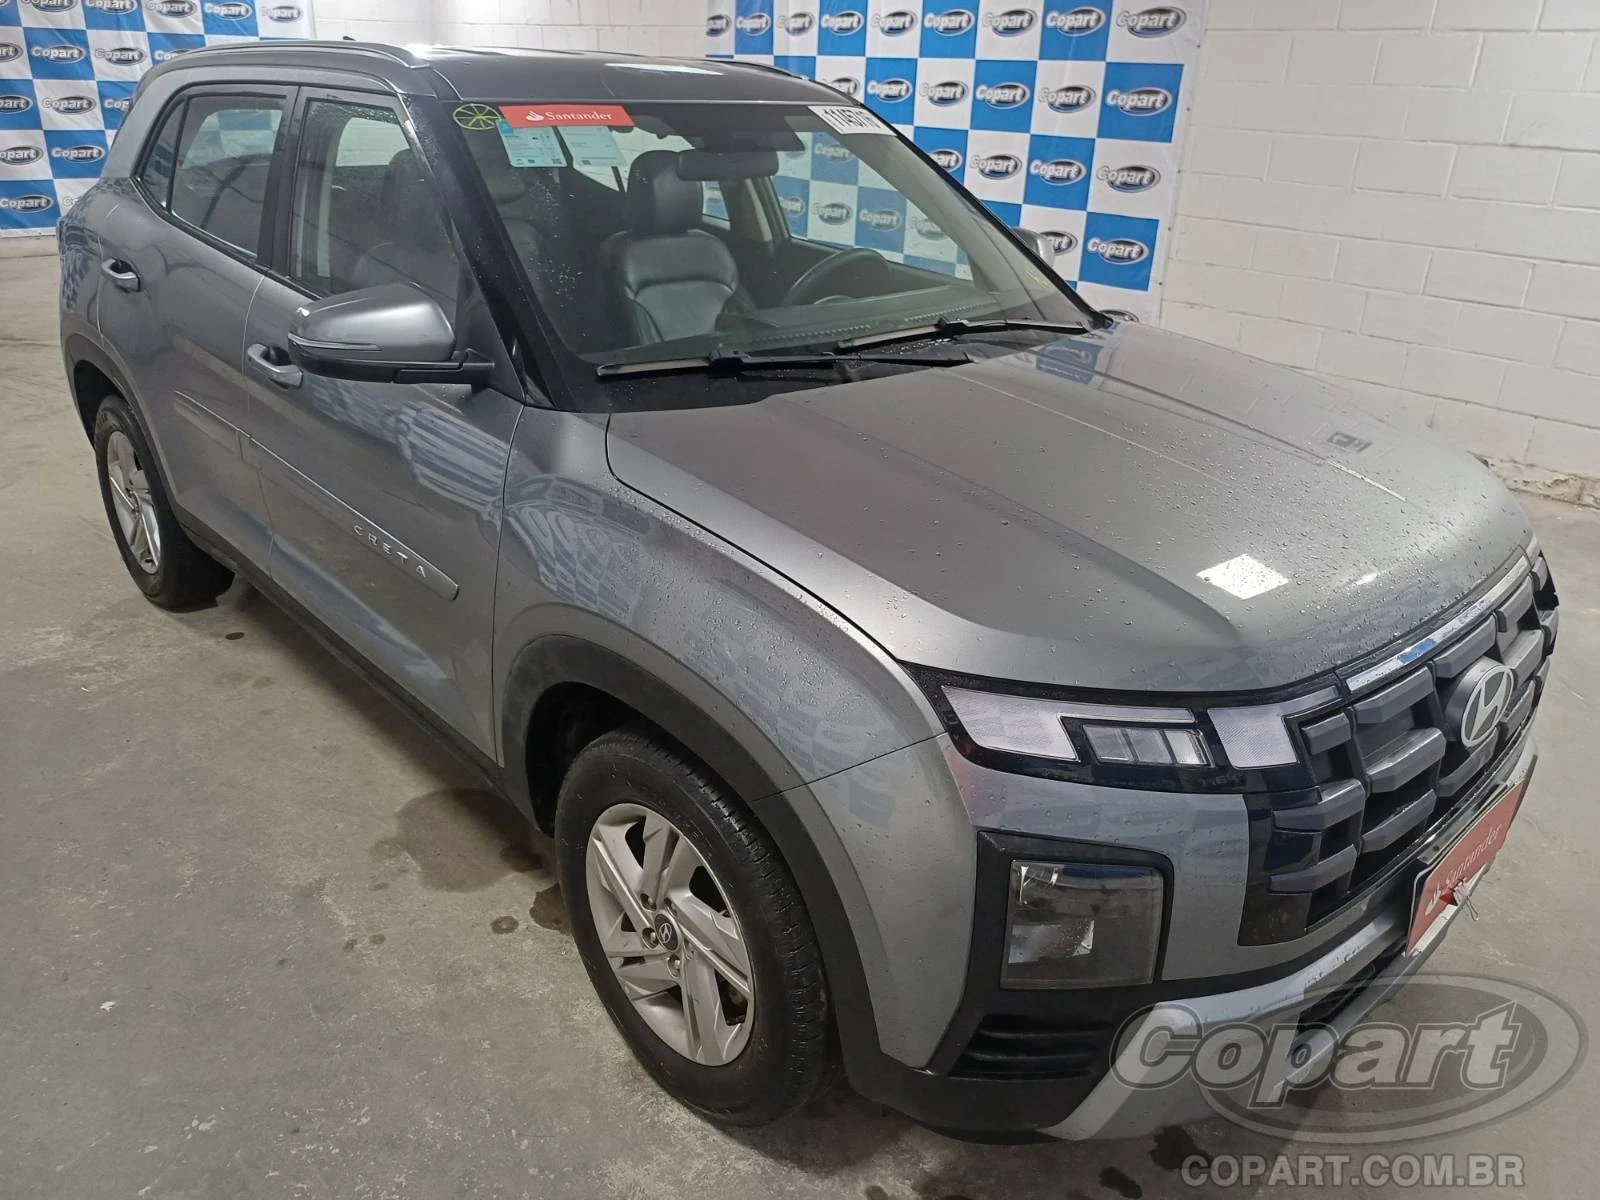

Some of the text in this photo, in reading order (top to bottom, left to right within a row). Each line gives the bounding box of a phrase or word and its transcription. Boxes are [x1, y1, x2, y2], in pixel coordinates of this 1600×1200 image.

[146, 1, 190, 13] Copart
[204, 3, 247, 16] Copart
[262, 6, 298, 18] Copart
[736, 15, 767, 31] Copart
[821, 13, 858, 30] Copart
[871, 13, 911, 31] Copart
[924, 12, 968, 31] Copart
[982, 12, 1031, 31] Copart
[1046, 11, 1096, 31] Copart
[1117, 11, 1175, 31] Copart
[32, 46, 79, 58] Copart
[95, 48, 139, 60] Copart
[867, 81, 907, 99] Copart
[920, 83, 963, 102] Copart
[976, 85, 1022, 104] Copart
[1039, 88, 1088, 106] Copart
[43, 98, 88, 111] Copart
[1107, 91, 1165, 111] Copart
[546, 111, 612, 120] Santander
[0, 149, 36, 160] opart
[51, 147, 100, 159] Copart
[970, 155, 1015, 173] Copart
[1030, 160, 1078, 179] Copart
[1096, 166, 1150, 184] Copart
[0, 198, 47, 209] Copart
[811, 203, 848, 219] Copart
[860, 210, 897, 226] Copart
[1088, 237, 1140, 258] Copart
[354, 525, 426, 578] CRETA
